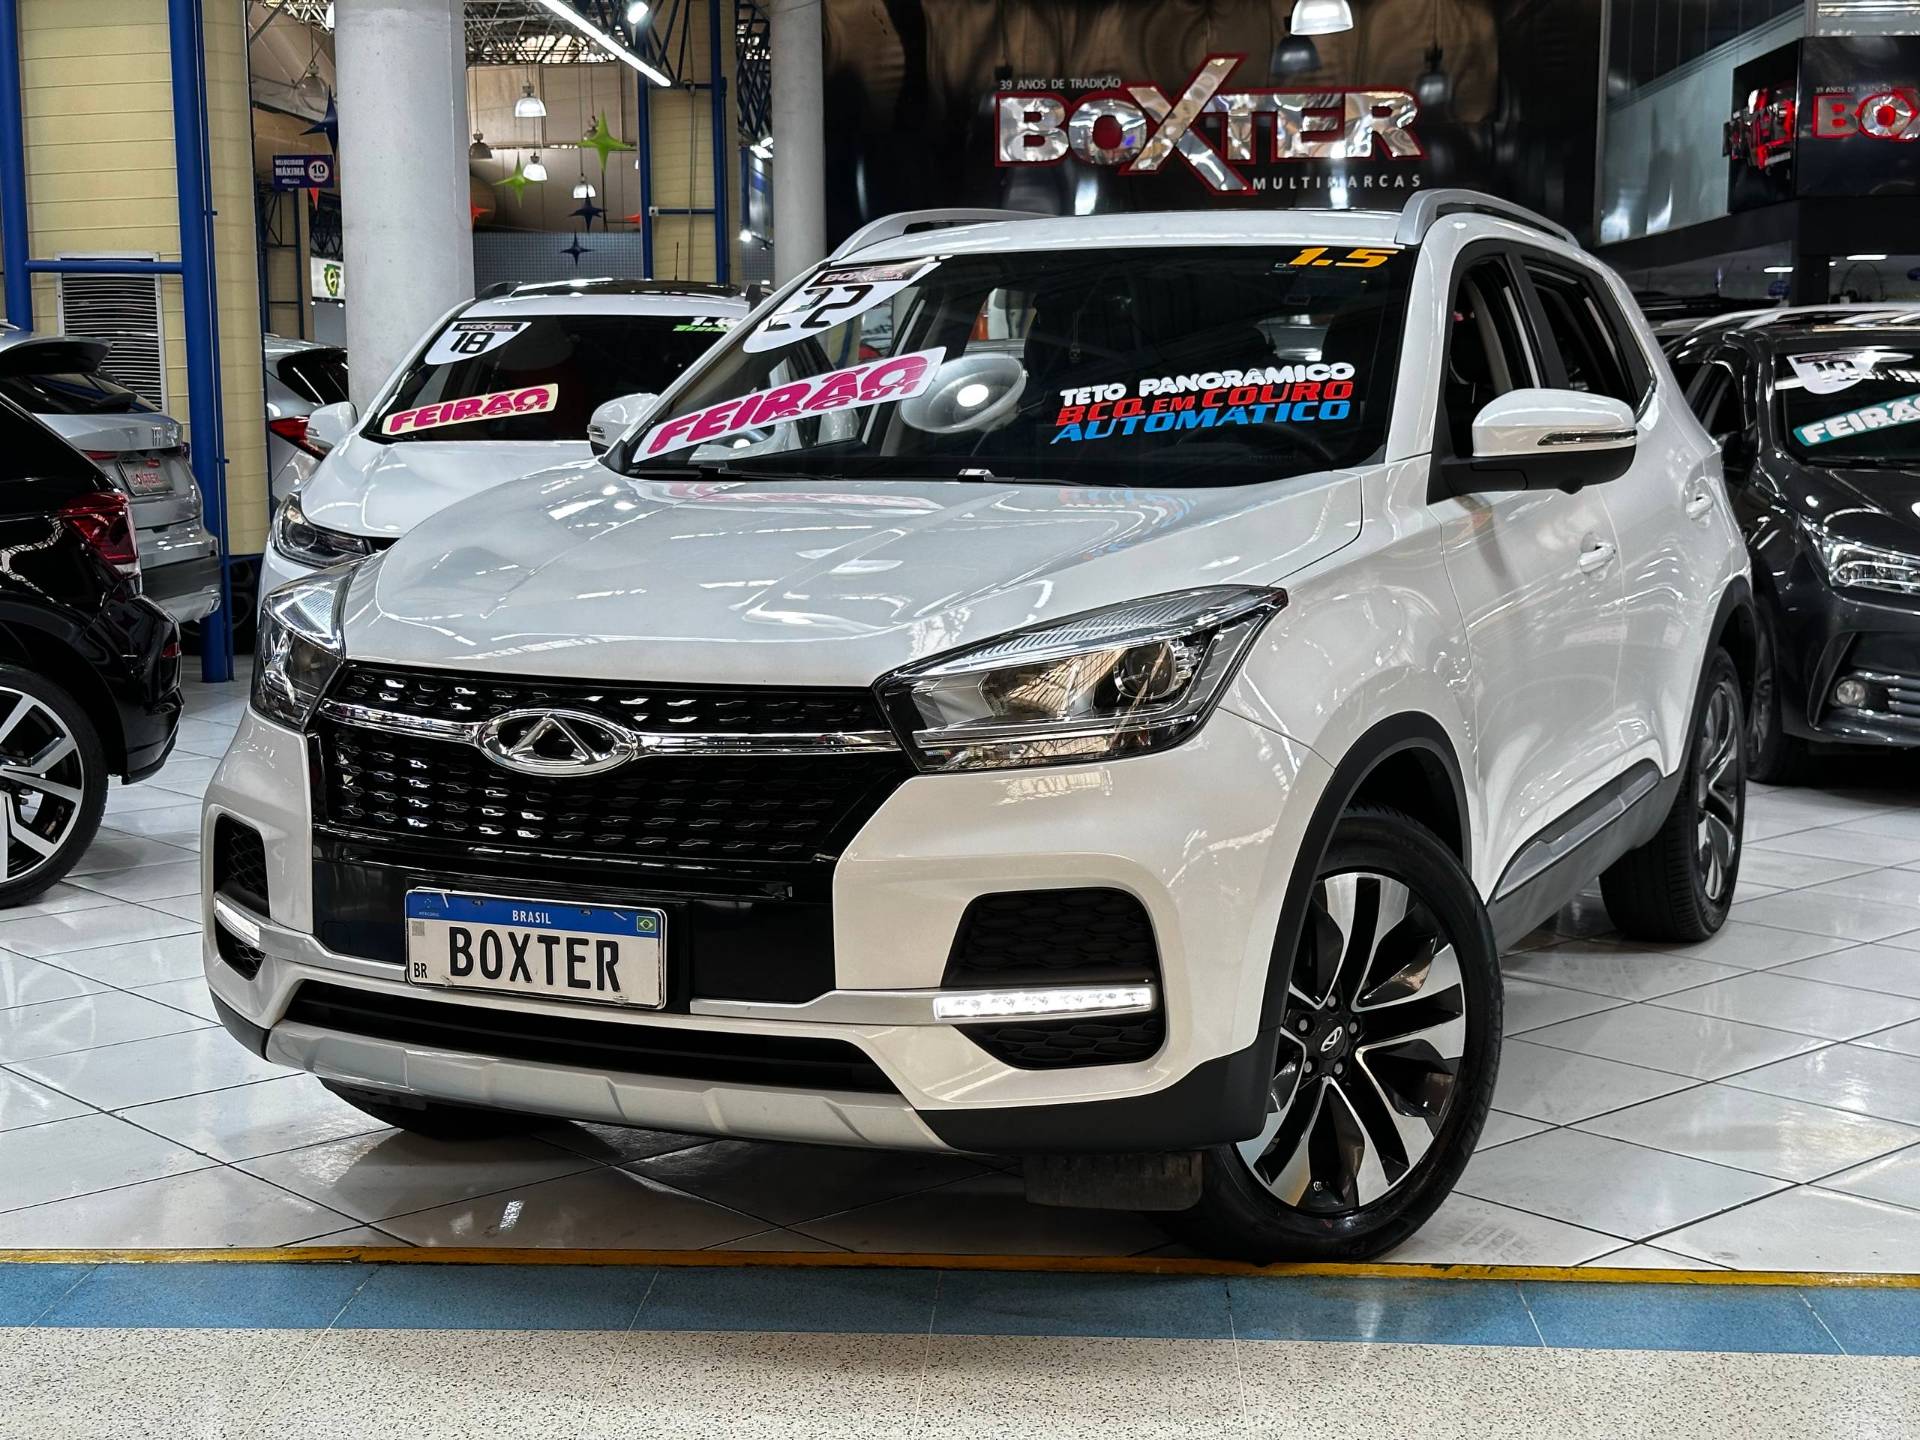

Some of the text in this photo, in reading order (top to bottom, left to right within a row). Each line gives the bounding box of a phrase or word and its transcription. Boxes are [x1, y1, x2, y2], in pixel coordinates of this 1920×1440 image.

[999, 75, 1121, 90] 39 ANOS DE TRADIÇÃO
[995, 53, 1427, 196] BOXTER
[311, 164, 326, 174] 10
[1252, 174, 1421, 190] MULTIMARCAS
[1288, 247, 1399, 268] 1.5
[460, 323, 513, 331] BOXTER
[449, 331, 496, 354] 18
[1060, 362, 1355, 406] TETO PANORÂMICO
[648, 356, 928, 454] FEIRÃO
[1151, 396, 1195, 413] EM
[1202, 381, 1354, 408] COURO
[389, 388, 549, 433] FEIRÃO
[512, 909, 552, 925] BRASIL
[449, 926, 622, 992] BOXTER
[413, 962, 428, 979] BR
